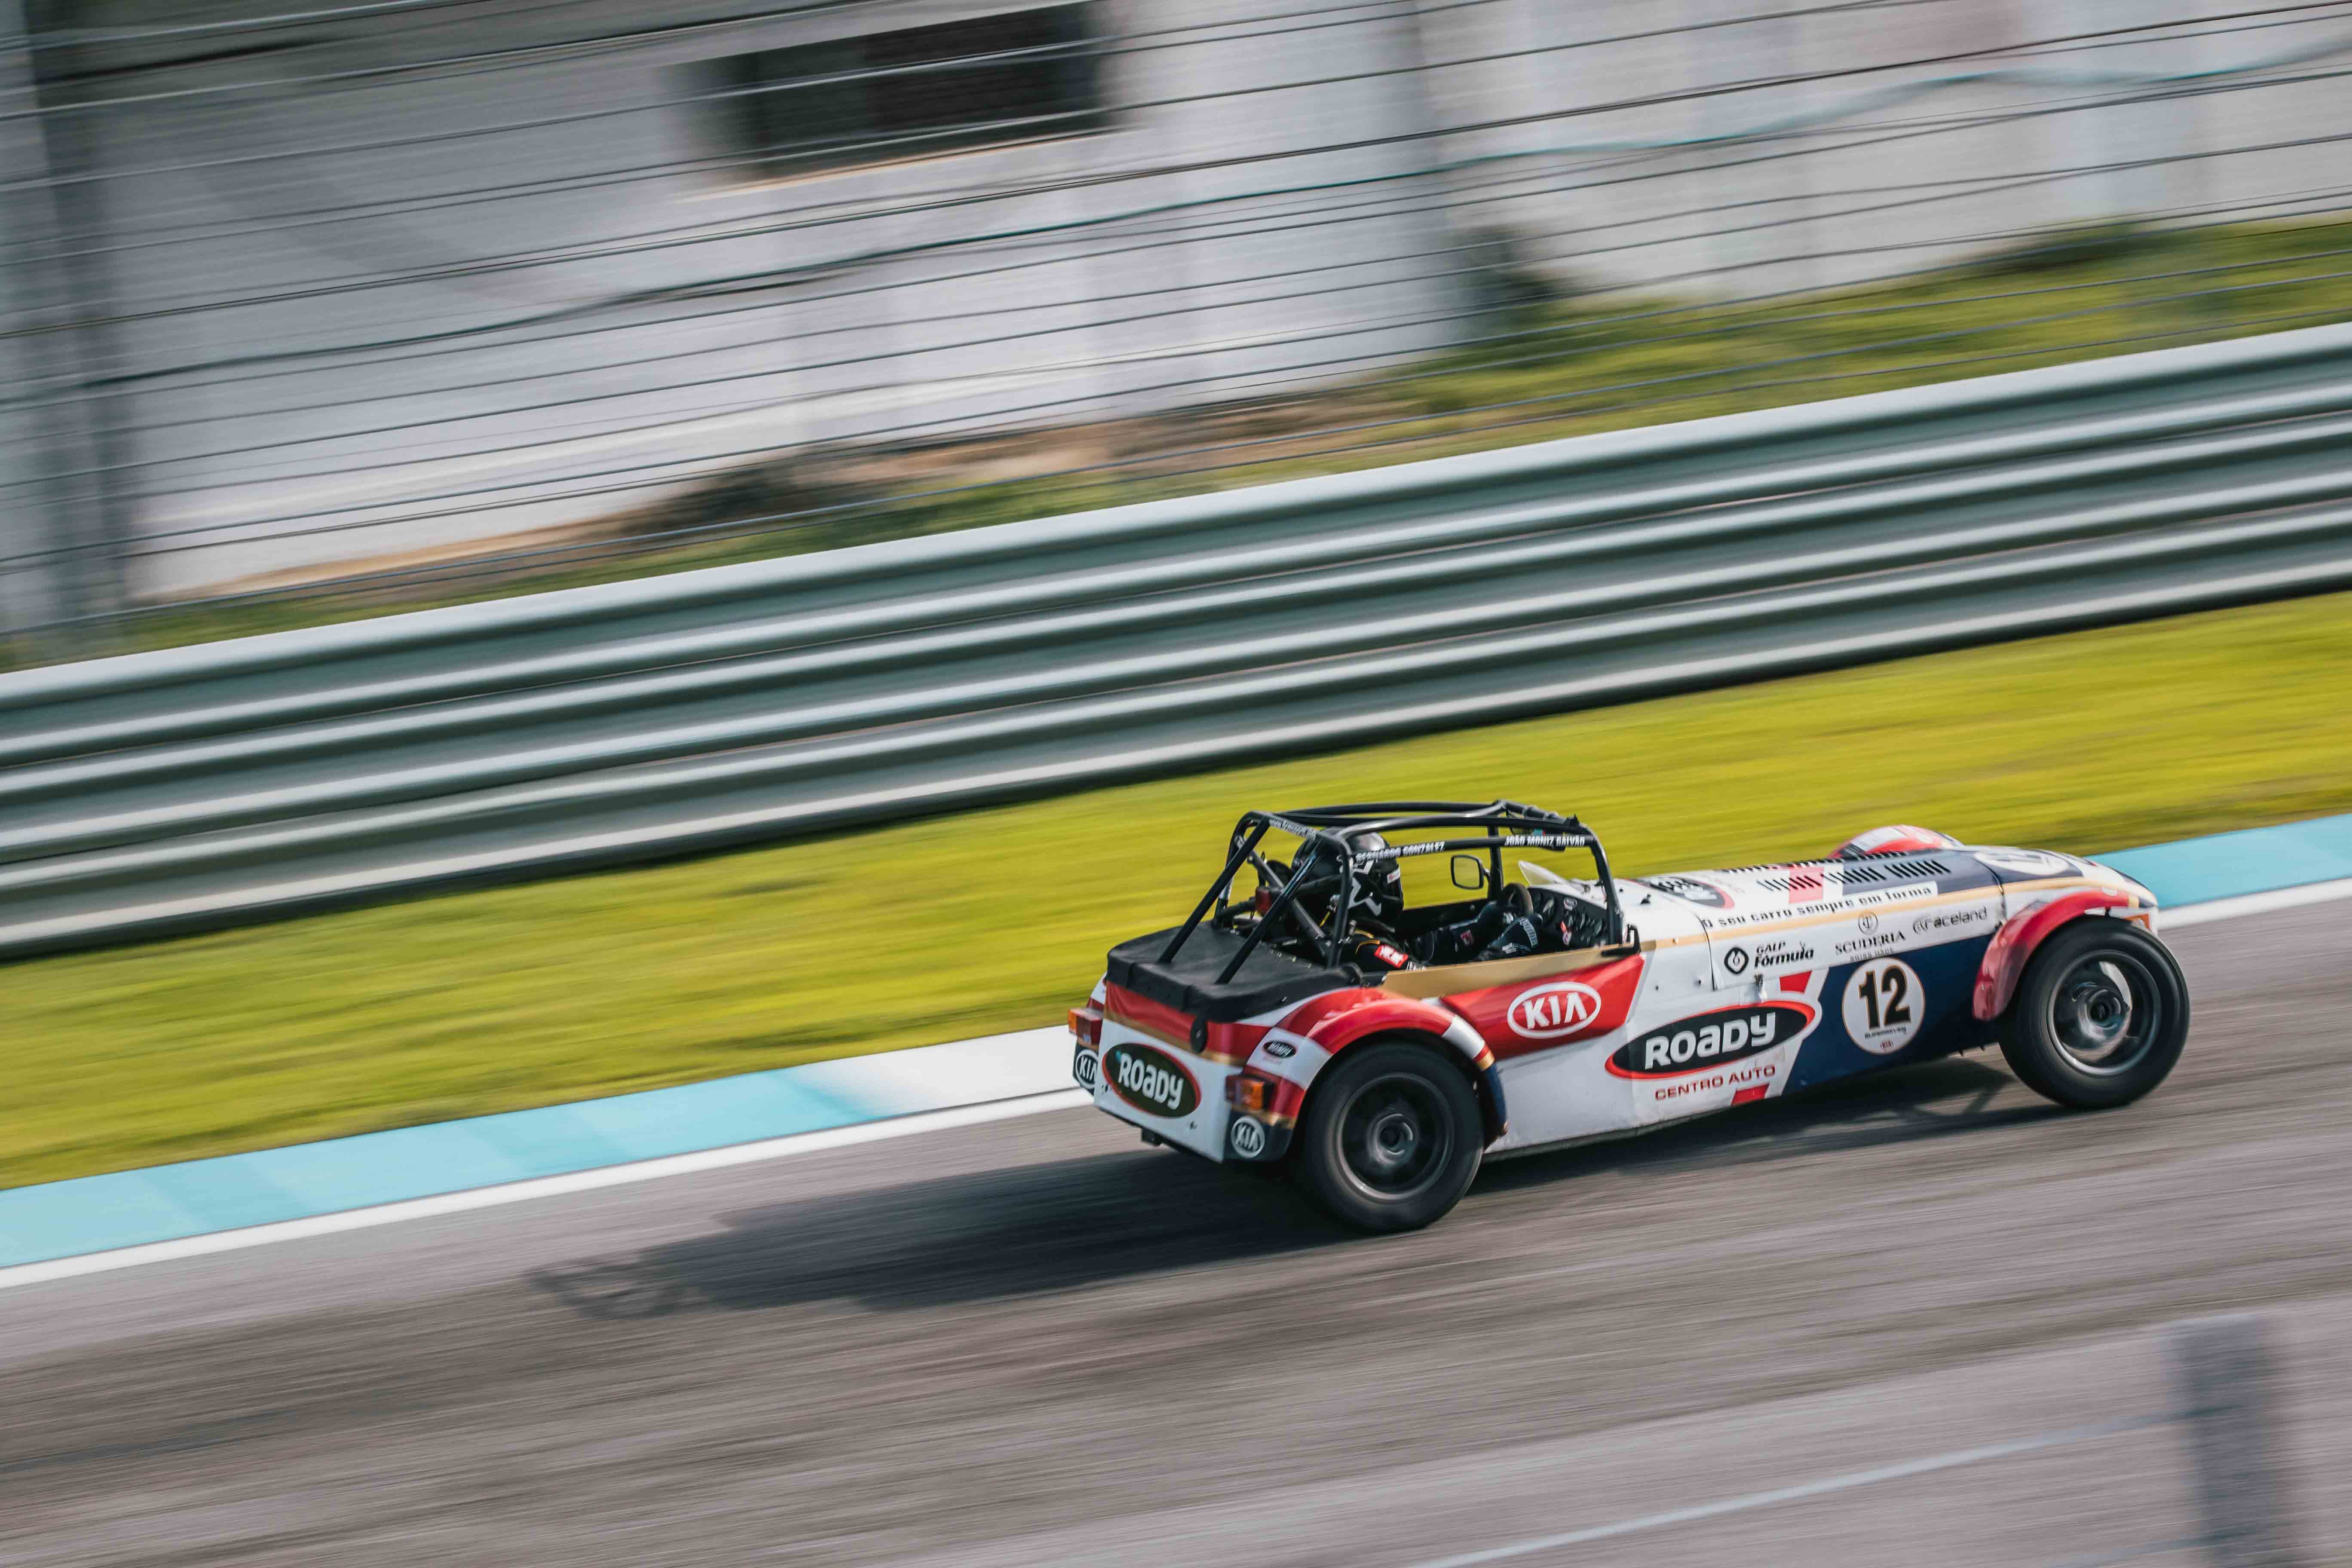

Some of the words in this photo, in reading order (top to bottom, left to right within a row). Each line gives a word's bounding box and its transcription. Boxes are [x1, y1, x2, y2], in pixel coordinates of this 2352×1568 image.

[1718, 916, 1746, 925] seu
[1751, 909, 1792, 921] carro
[1797, 900, 1853, 913] sempre
[1859, 895, 1881, 904] em
[1885, 887, 1932, 900] forma
[1924, 906, 1988, 930] raceland
[1756, 941, 1785, 953] GALP
[1835, 931, 1905, 956] SCUDERIA
[1522, 992, 1587, 1029] KIA
[1858, 965, 1911, 1029] 12
[1079, 1056, 1097, 1081] KIA
[1655, 1075, 1724, 1101] CENTRO
[1728, 1064, 1776, 1085] AUTO
[1235, 1124, 1258, 1151] KIA
